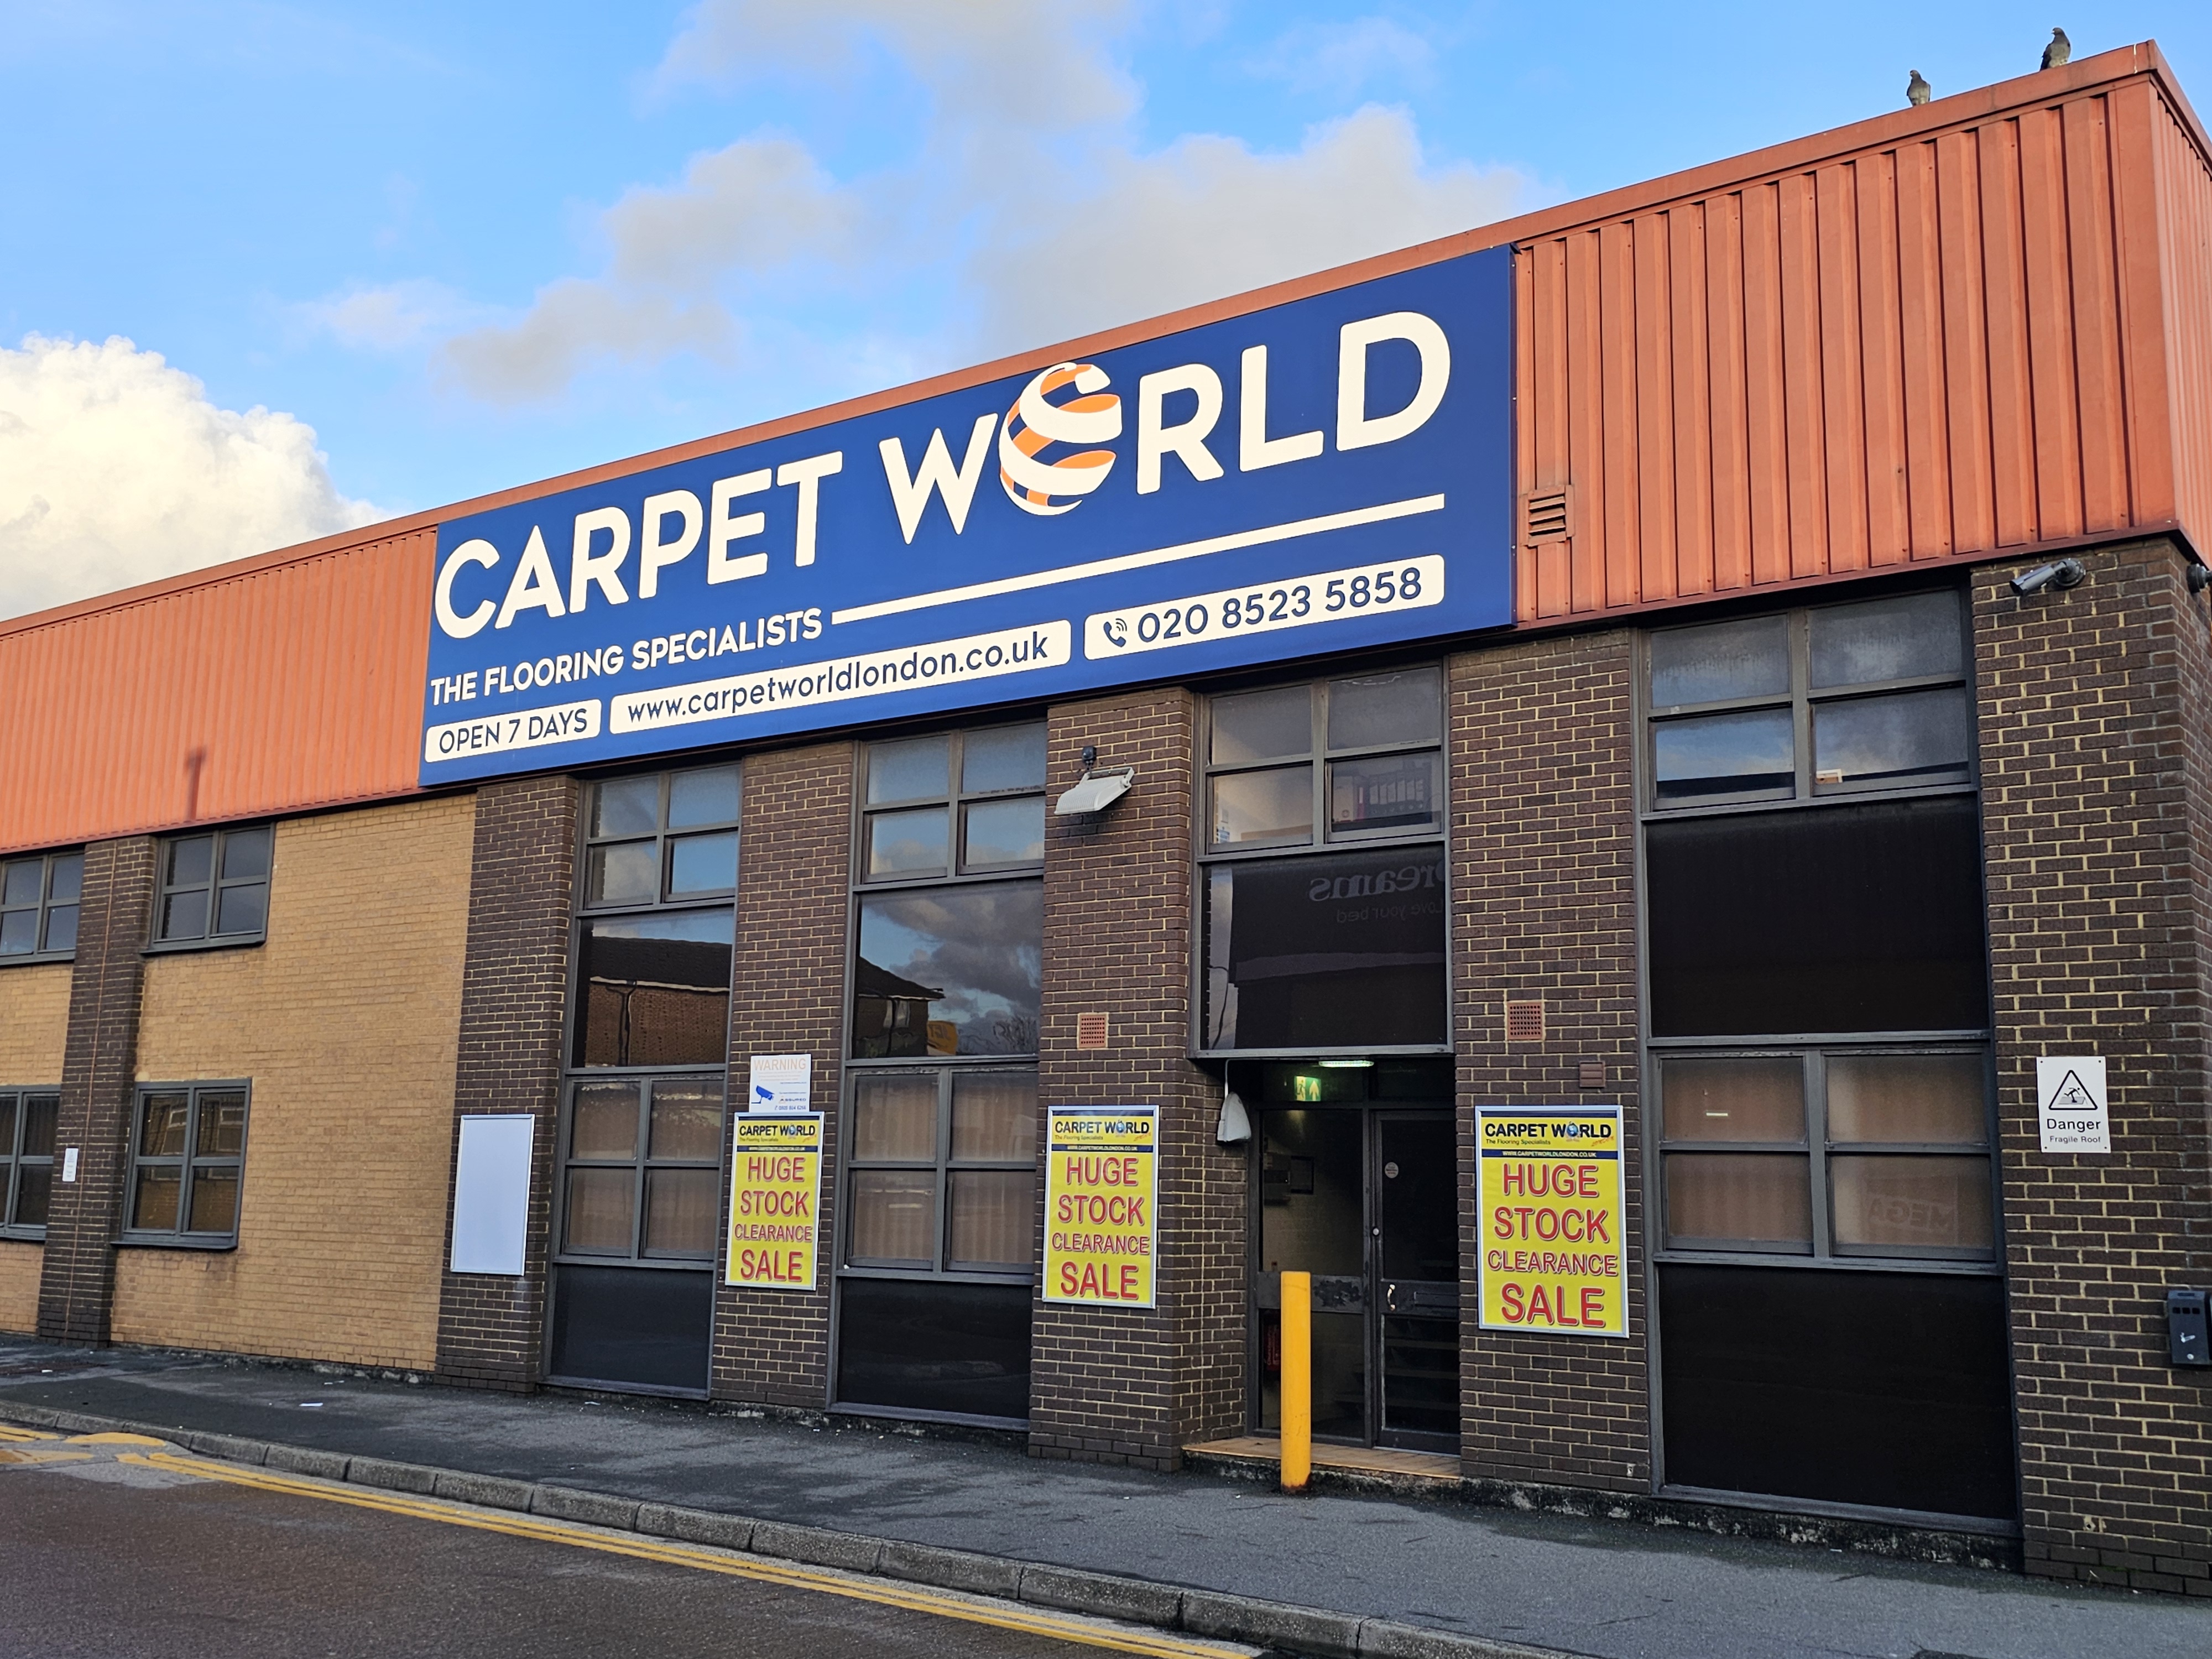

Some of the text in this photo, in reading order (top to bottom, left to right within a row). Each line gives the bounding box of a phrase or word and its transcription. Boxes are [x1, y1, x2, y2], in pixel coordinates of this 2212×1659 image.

[435, 312, 1451, 639] CARPET WORLD
[1138, 567, 1422, 643] 020 8523 5858
[430, 608, 822, 706] THE FLOORING SPECIALISTS
[628, 631, 1048, 723] www.carpetworldlondon.co.uk
[439, 708, 587, 754] OPEN 7 DAYS
[754, 1058, 806, 1071] WARNING
[739, 1124, 816, 1136] CARPET WORLD
[1055, 1120, 1150, 1134] CARPET WORLD
[1485, 1121, 1612, 1138] CARPET WORLD
[2047, 1118, 2101, 1133] Danger
[2049, 1135, 2078, 1144] Fragile
[748, 1156, 806, 1182] HUGE
[1066, 1156, 1139, 1186] HUGE
[1502, 1162, 1599, 1197] HUGE
[740, 1190, 810, 1217] STOCK
[1057, 1193, 1145, 1227] STOCK
[734, 1223, 813, 1243] CLEARANCE
[1494, 1206, 1610, 1244] STOCK
[1051, 1232, 1150, 1255] CLEARANCE
[740, 1248, 804, 1282] SALE
[1487, 1249, 1619, 1276] CLEARANCE
[1060, 1260, 1139, 1301] SALE
[1500, 1282, 1606, 1328] SALE
